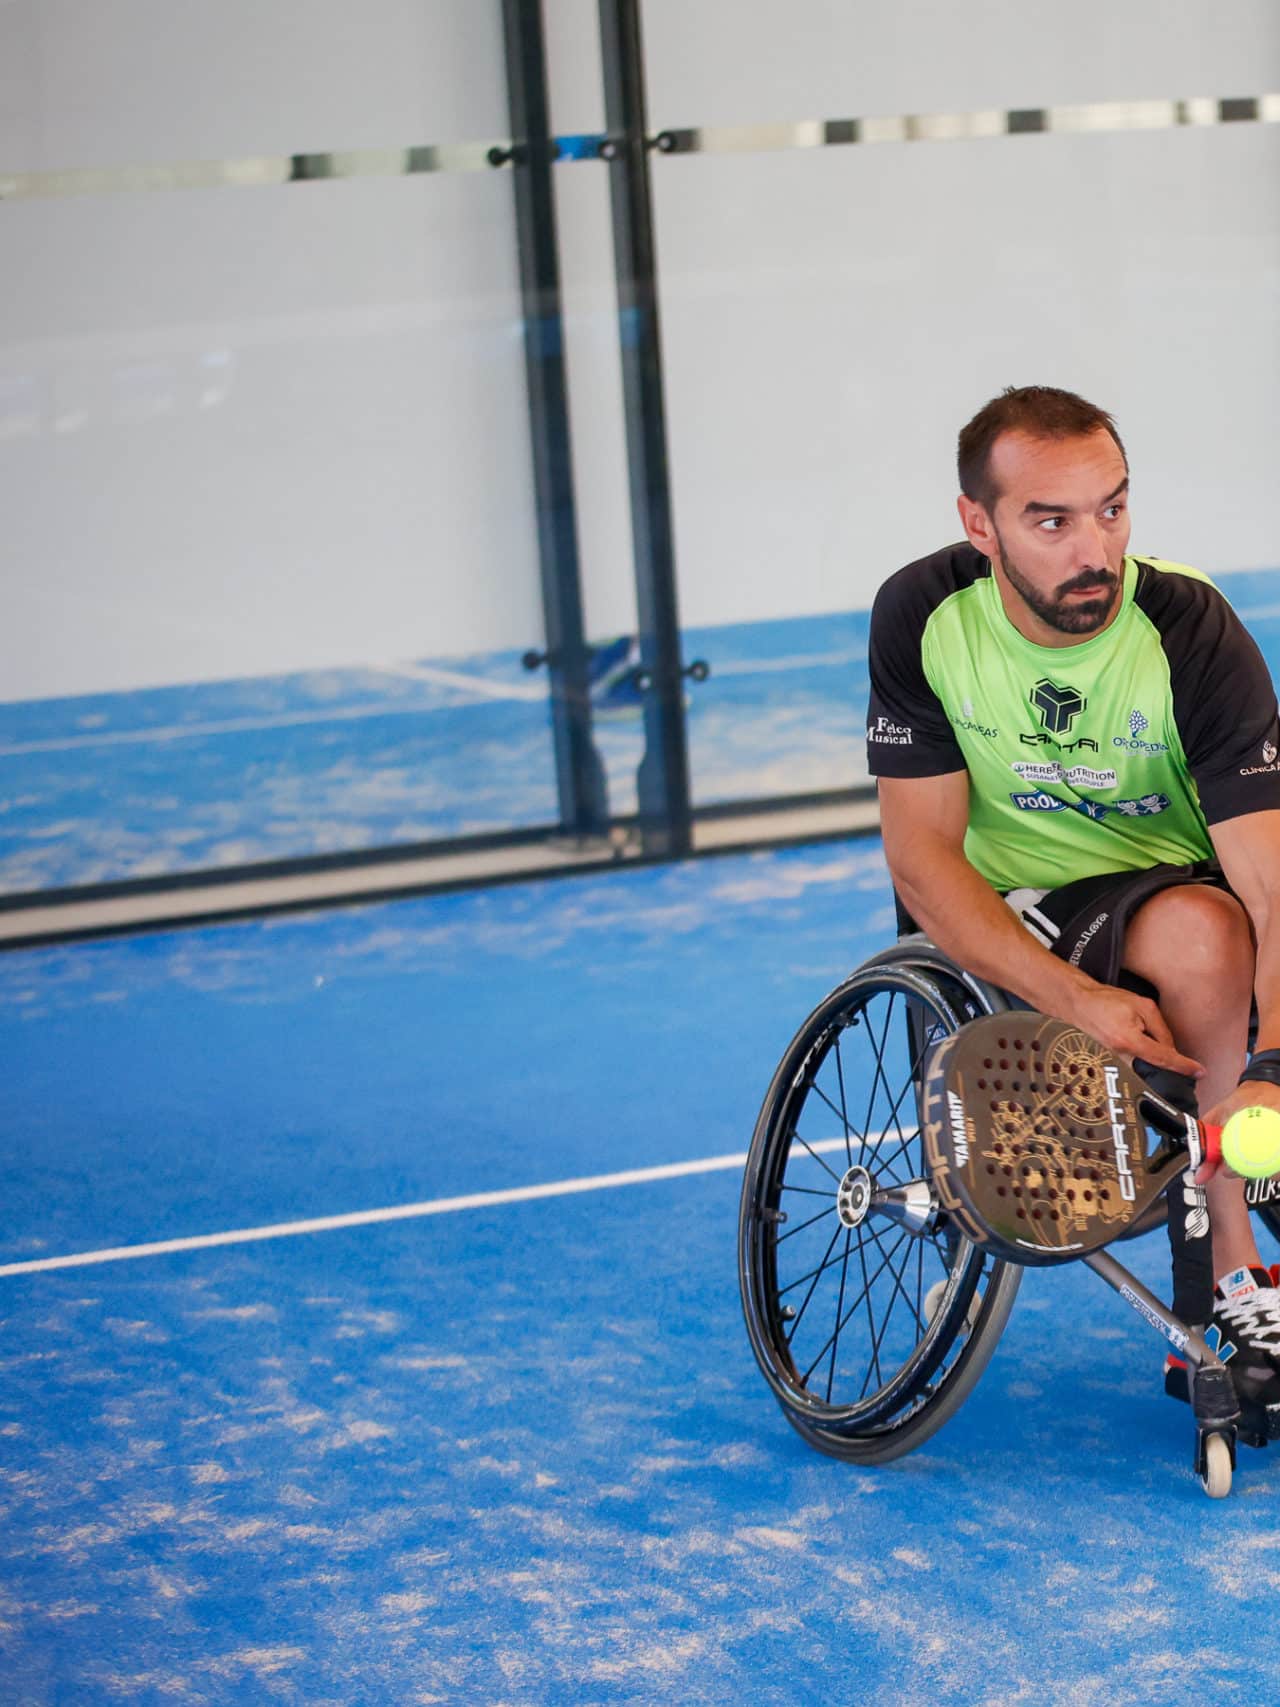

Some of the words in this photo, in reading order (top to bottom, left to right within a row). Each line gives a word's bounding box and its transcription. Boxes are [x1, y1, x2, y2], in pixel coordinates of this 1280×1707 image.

[876, 717, 912, 734] Felco
[946, 1089, 970, 1169] TAMARIT
[1103, 1066, 1136, 1201] CARTRI
